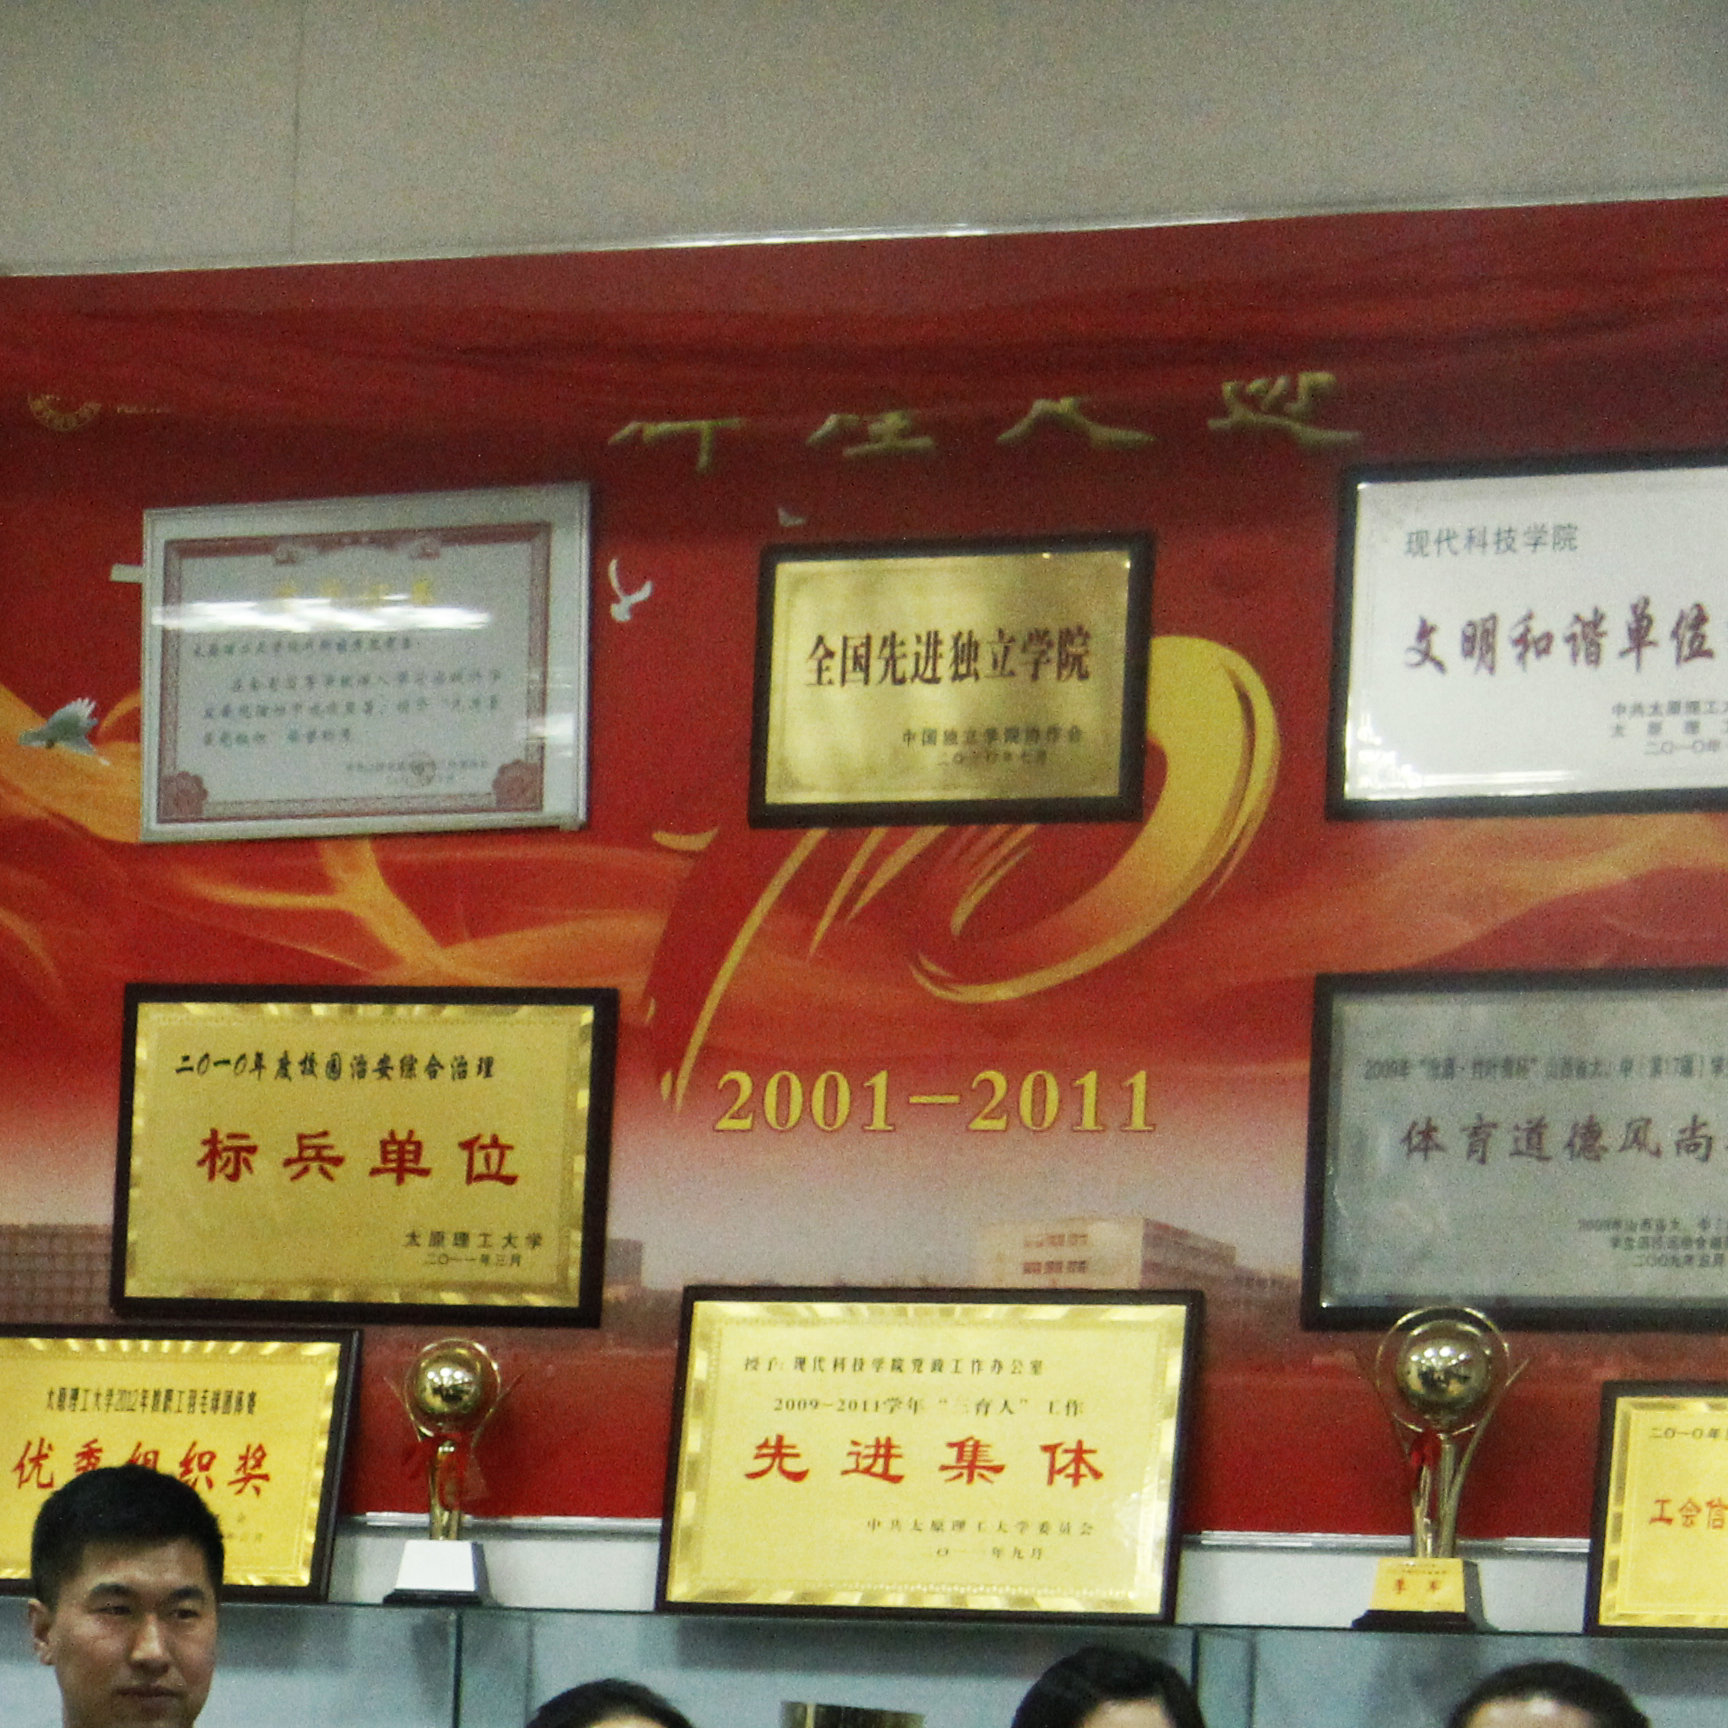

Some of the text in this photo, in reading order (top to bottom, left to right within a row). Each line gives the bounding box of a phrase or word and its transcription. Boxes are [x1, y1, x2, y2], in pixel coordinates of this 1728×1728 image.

[1405, 522, 1579, 558] 现代科技学院
[804, 623, 1092, 687] 全国先进独立学院
[1405, 595, 1715, 676] 文明和谐单位
[197, 1127, 520, 1186] 标兵单位
[1400, 1112, 1713, 1165] 体育道德风尚
[405, 1229, 544, 1250] 太原理工大学
[744, 1433, 1105, 1488] 先进集体
